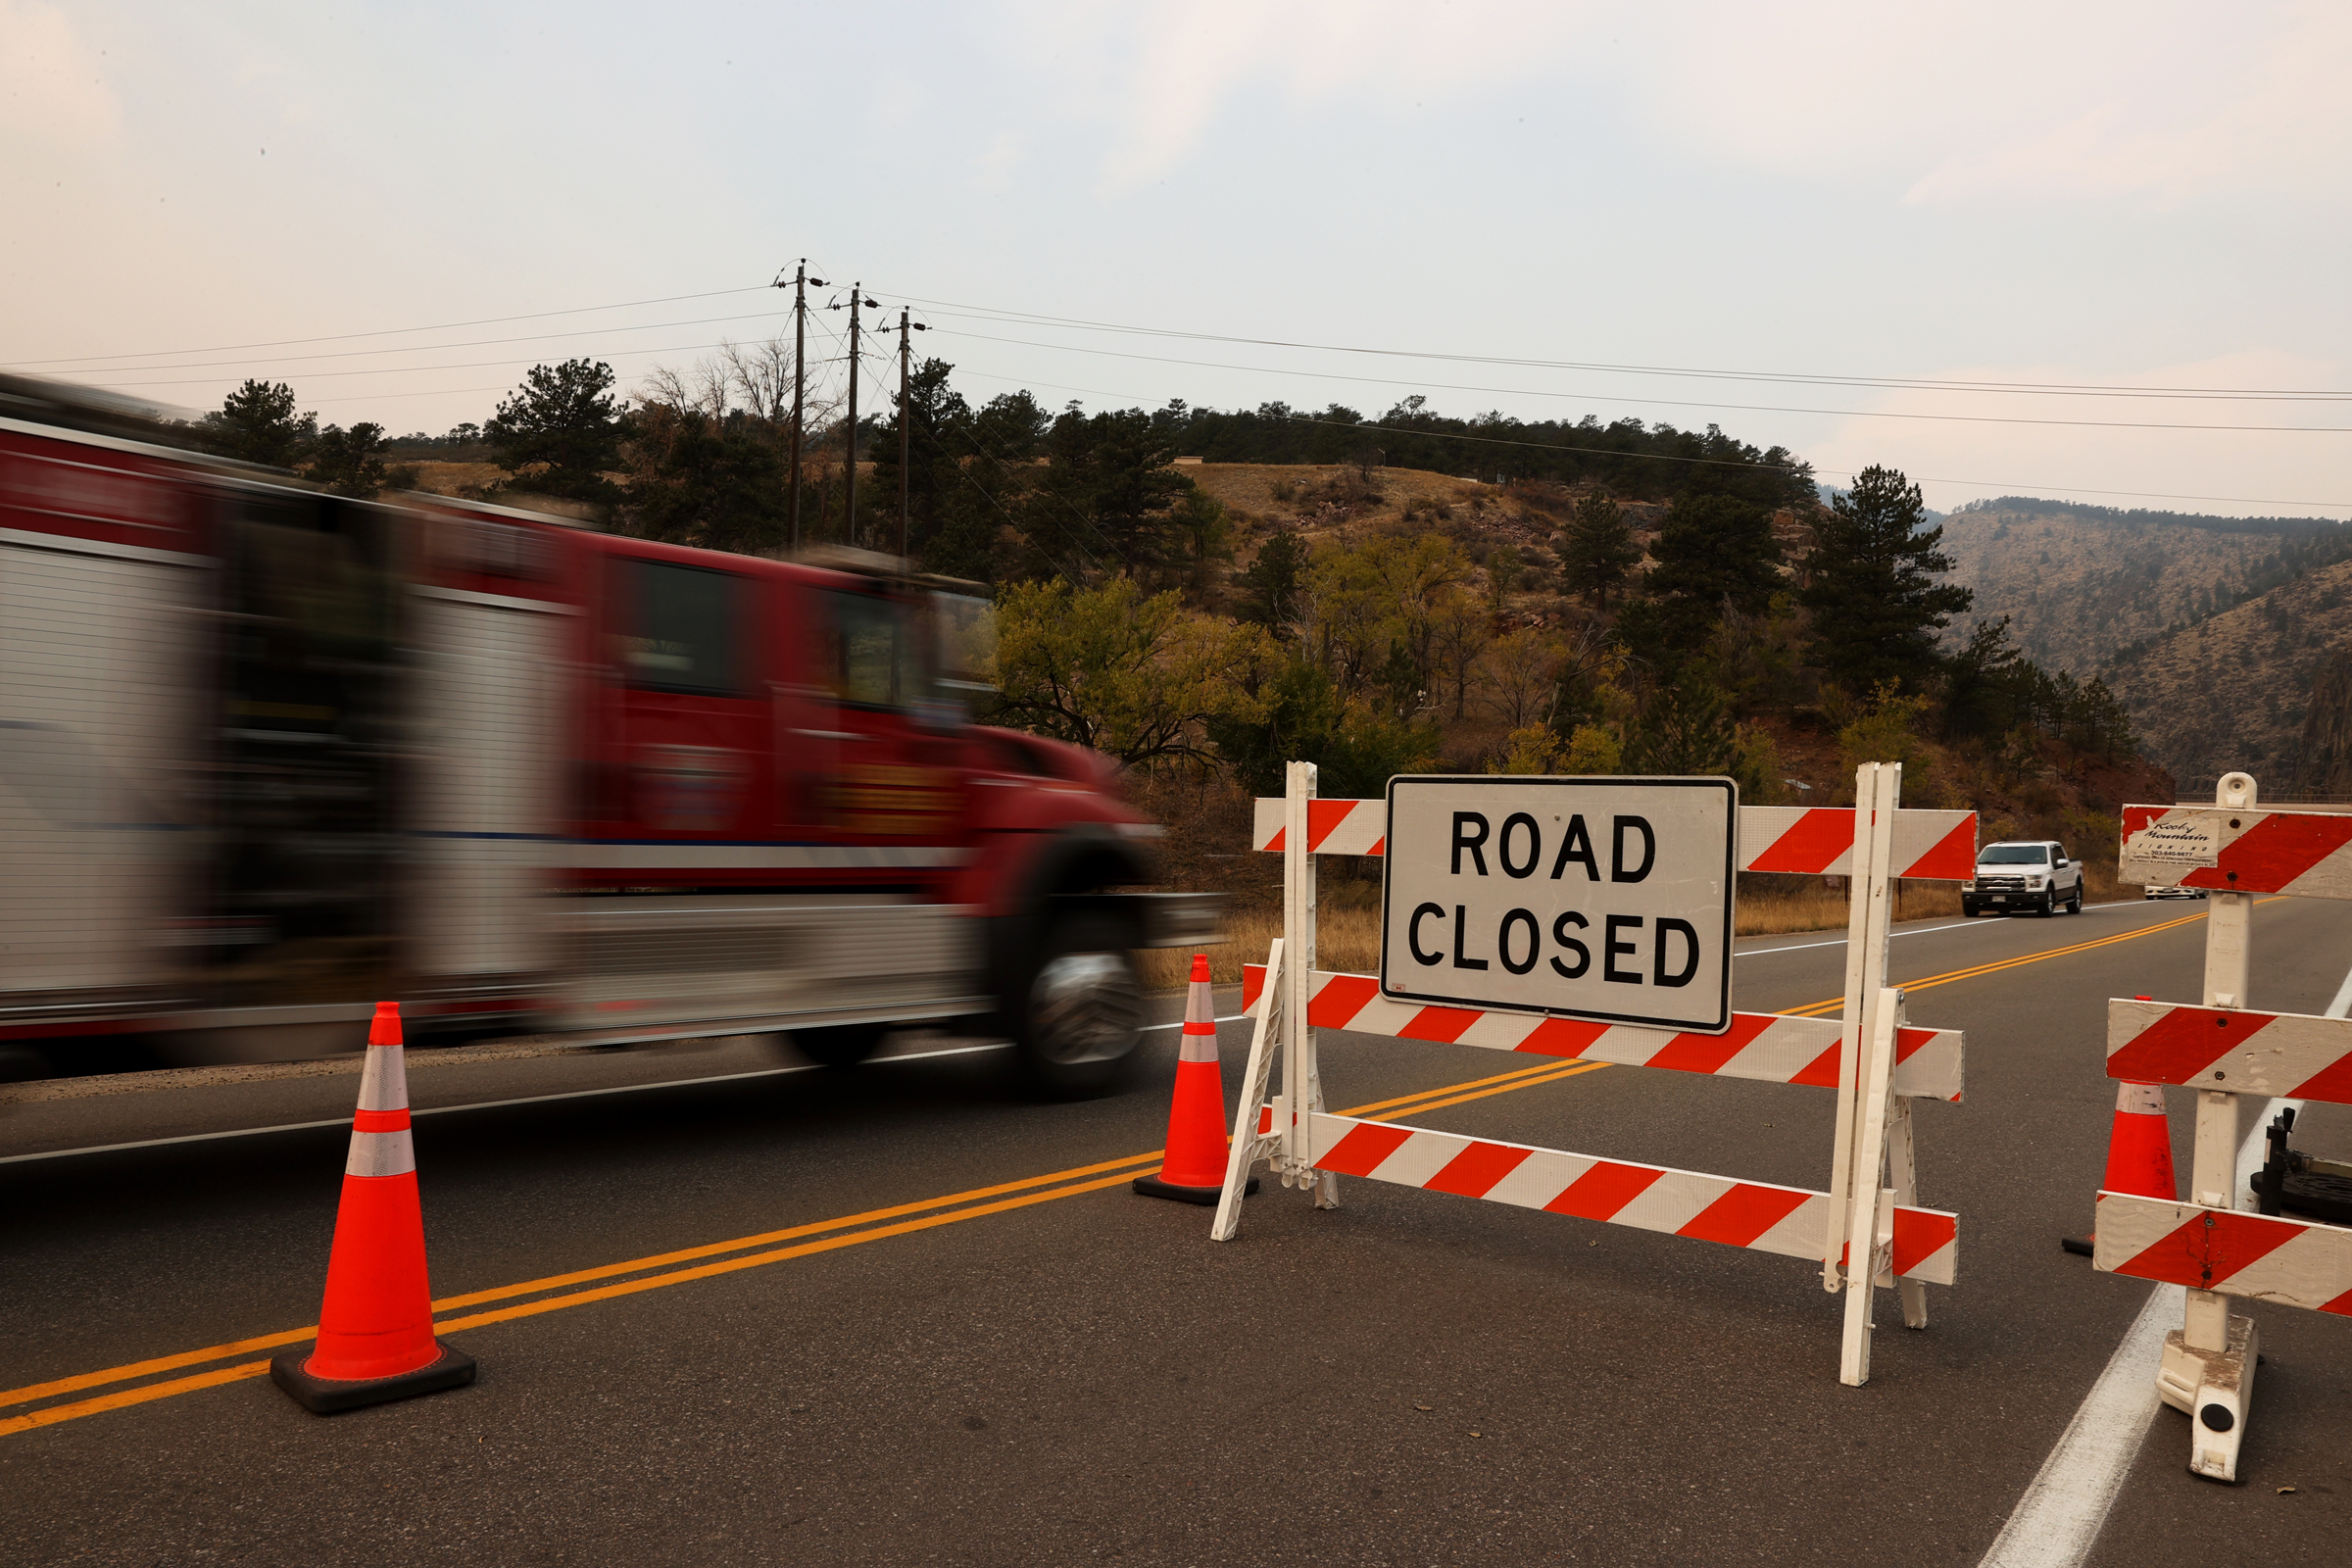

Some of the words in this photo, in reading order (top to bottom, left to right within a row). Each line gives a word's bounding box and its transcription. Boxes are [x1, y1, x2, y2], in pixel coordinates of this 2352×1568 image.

[1450, 810, 1656, 884] ROAD
[2144, 830, 2210, 842] Mountain
[1408, 902, 1700, 988] CLOSED
